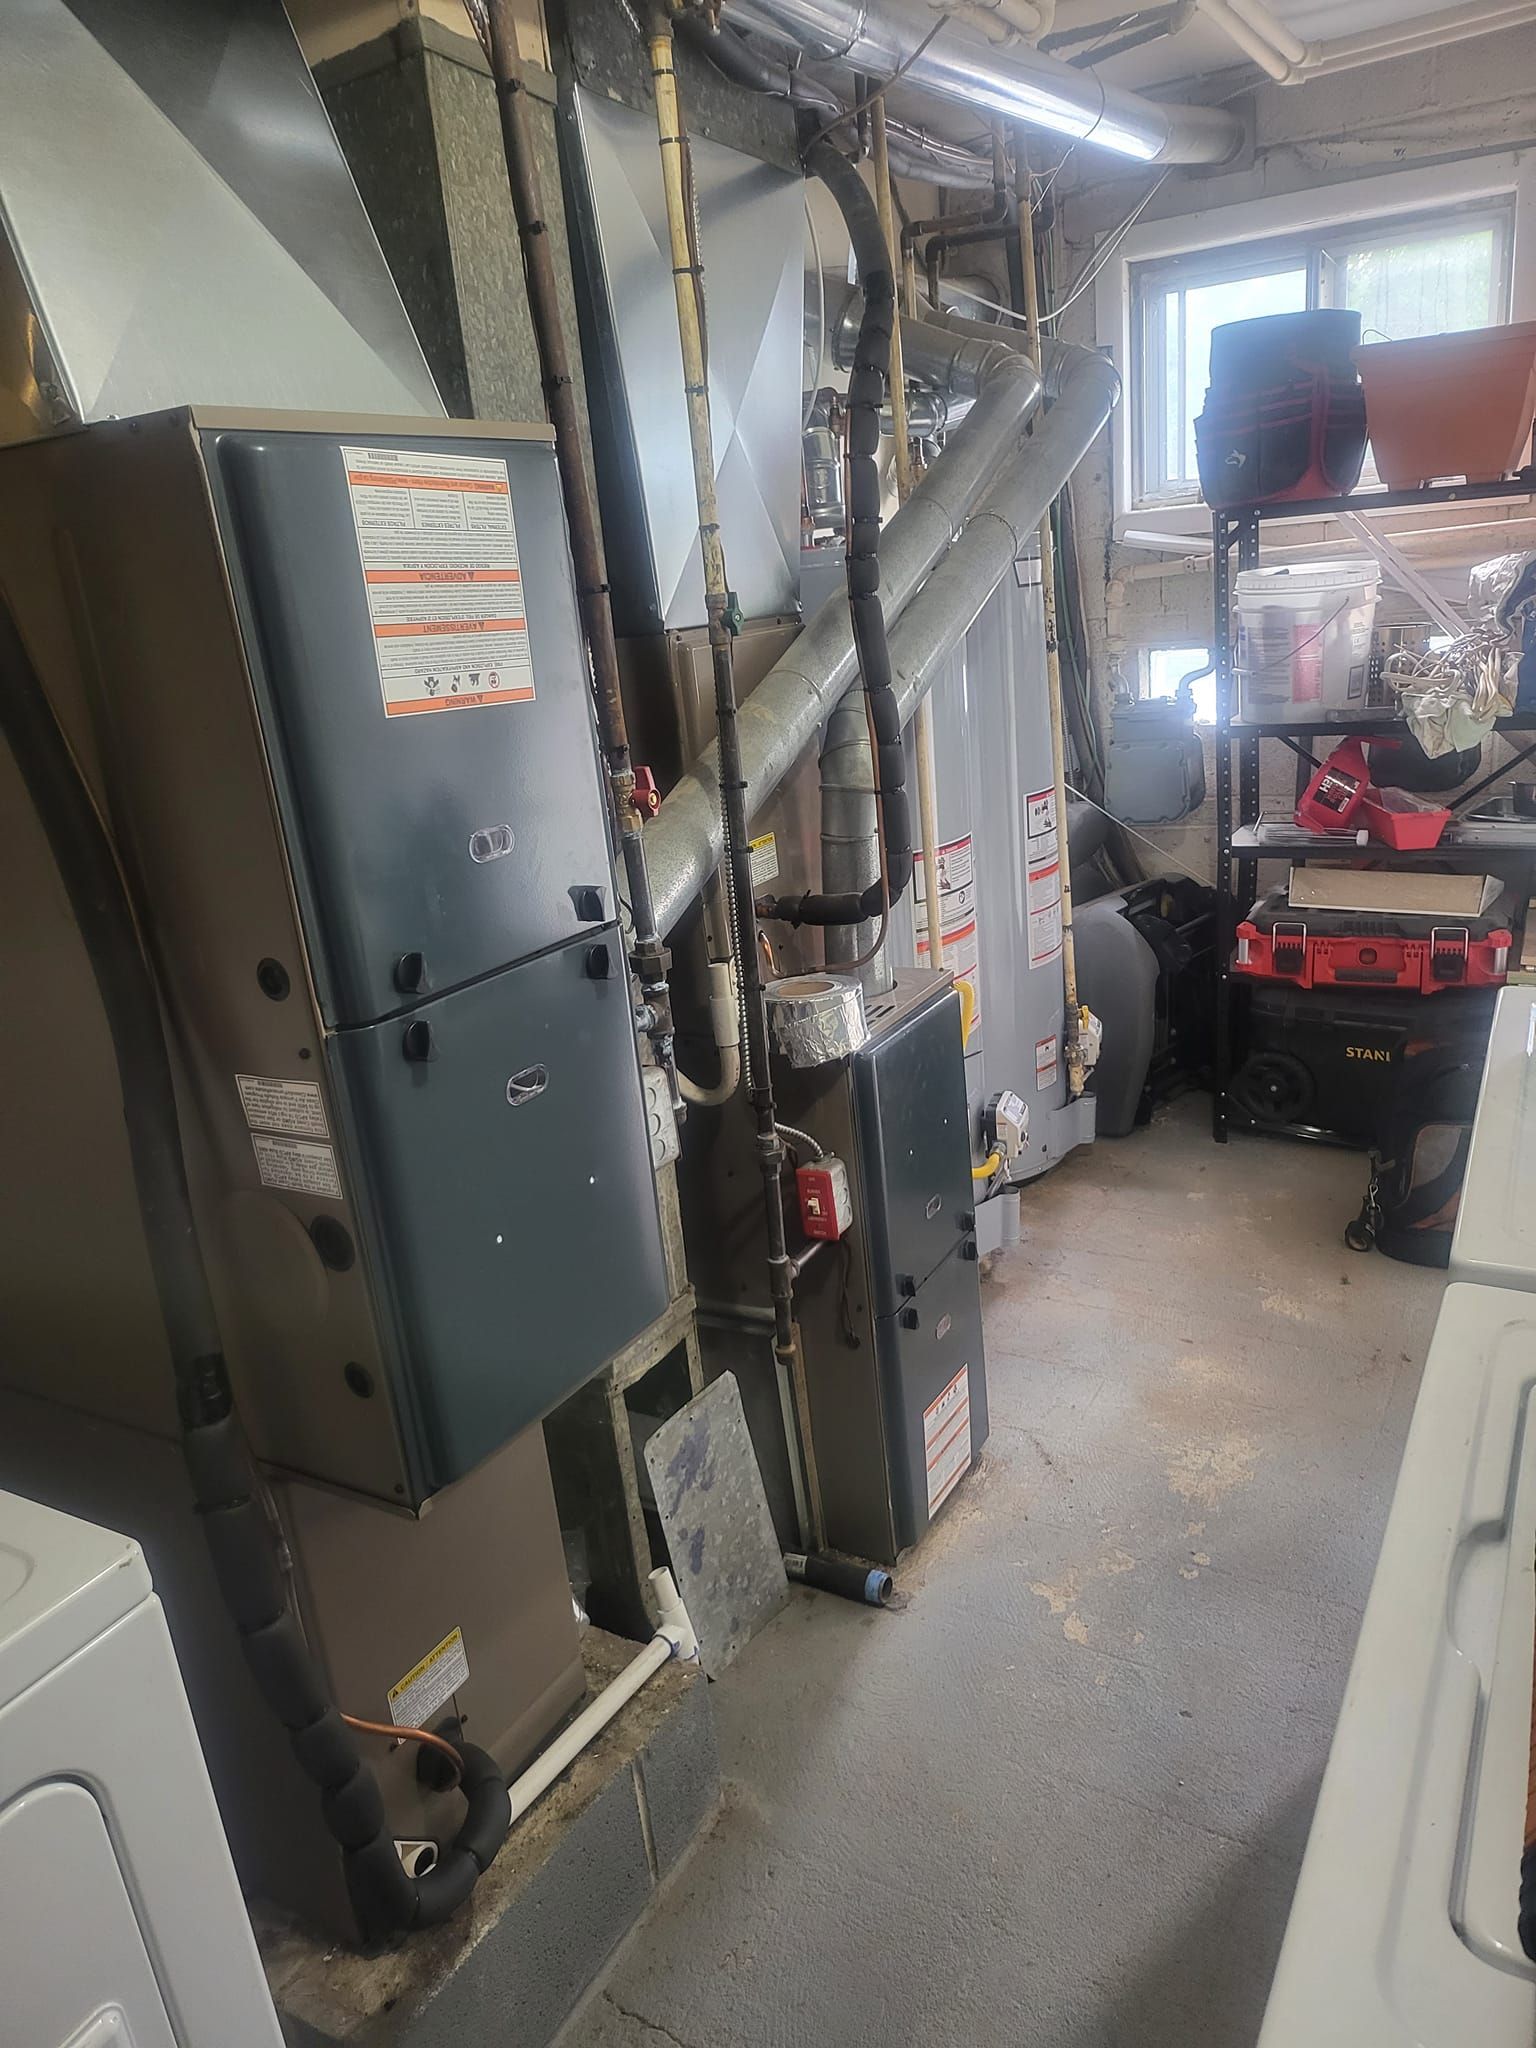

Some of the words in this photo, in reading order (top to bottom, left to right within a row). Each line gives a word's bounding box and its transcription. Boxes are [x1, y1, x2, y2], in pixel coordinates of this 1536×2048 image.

[418, 571, 467, 581] ADVERTENCIA
[422, 622, 477, 633] AVERTISSEMENT
[444, 695, 476, 706] WARNING
[400, 1664, 426, 1690] CAUTION
[429, 1633, 458, 1663] ATTENTION
